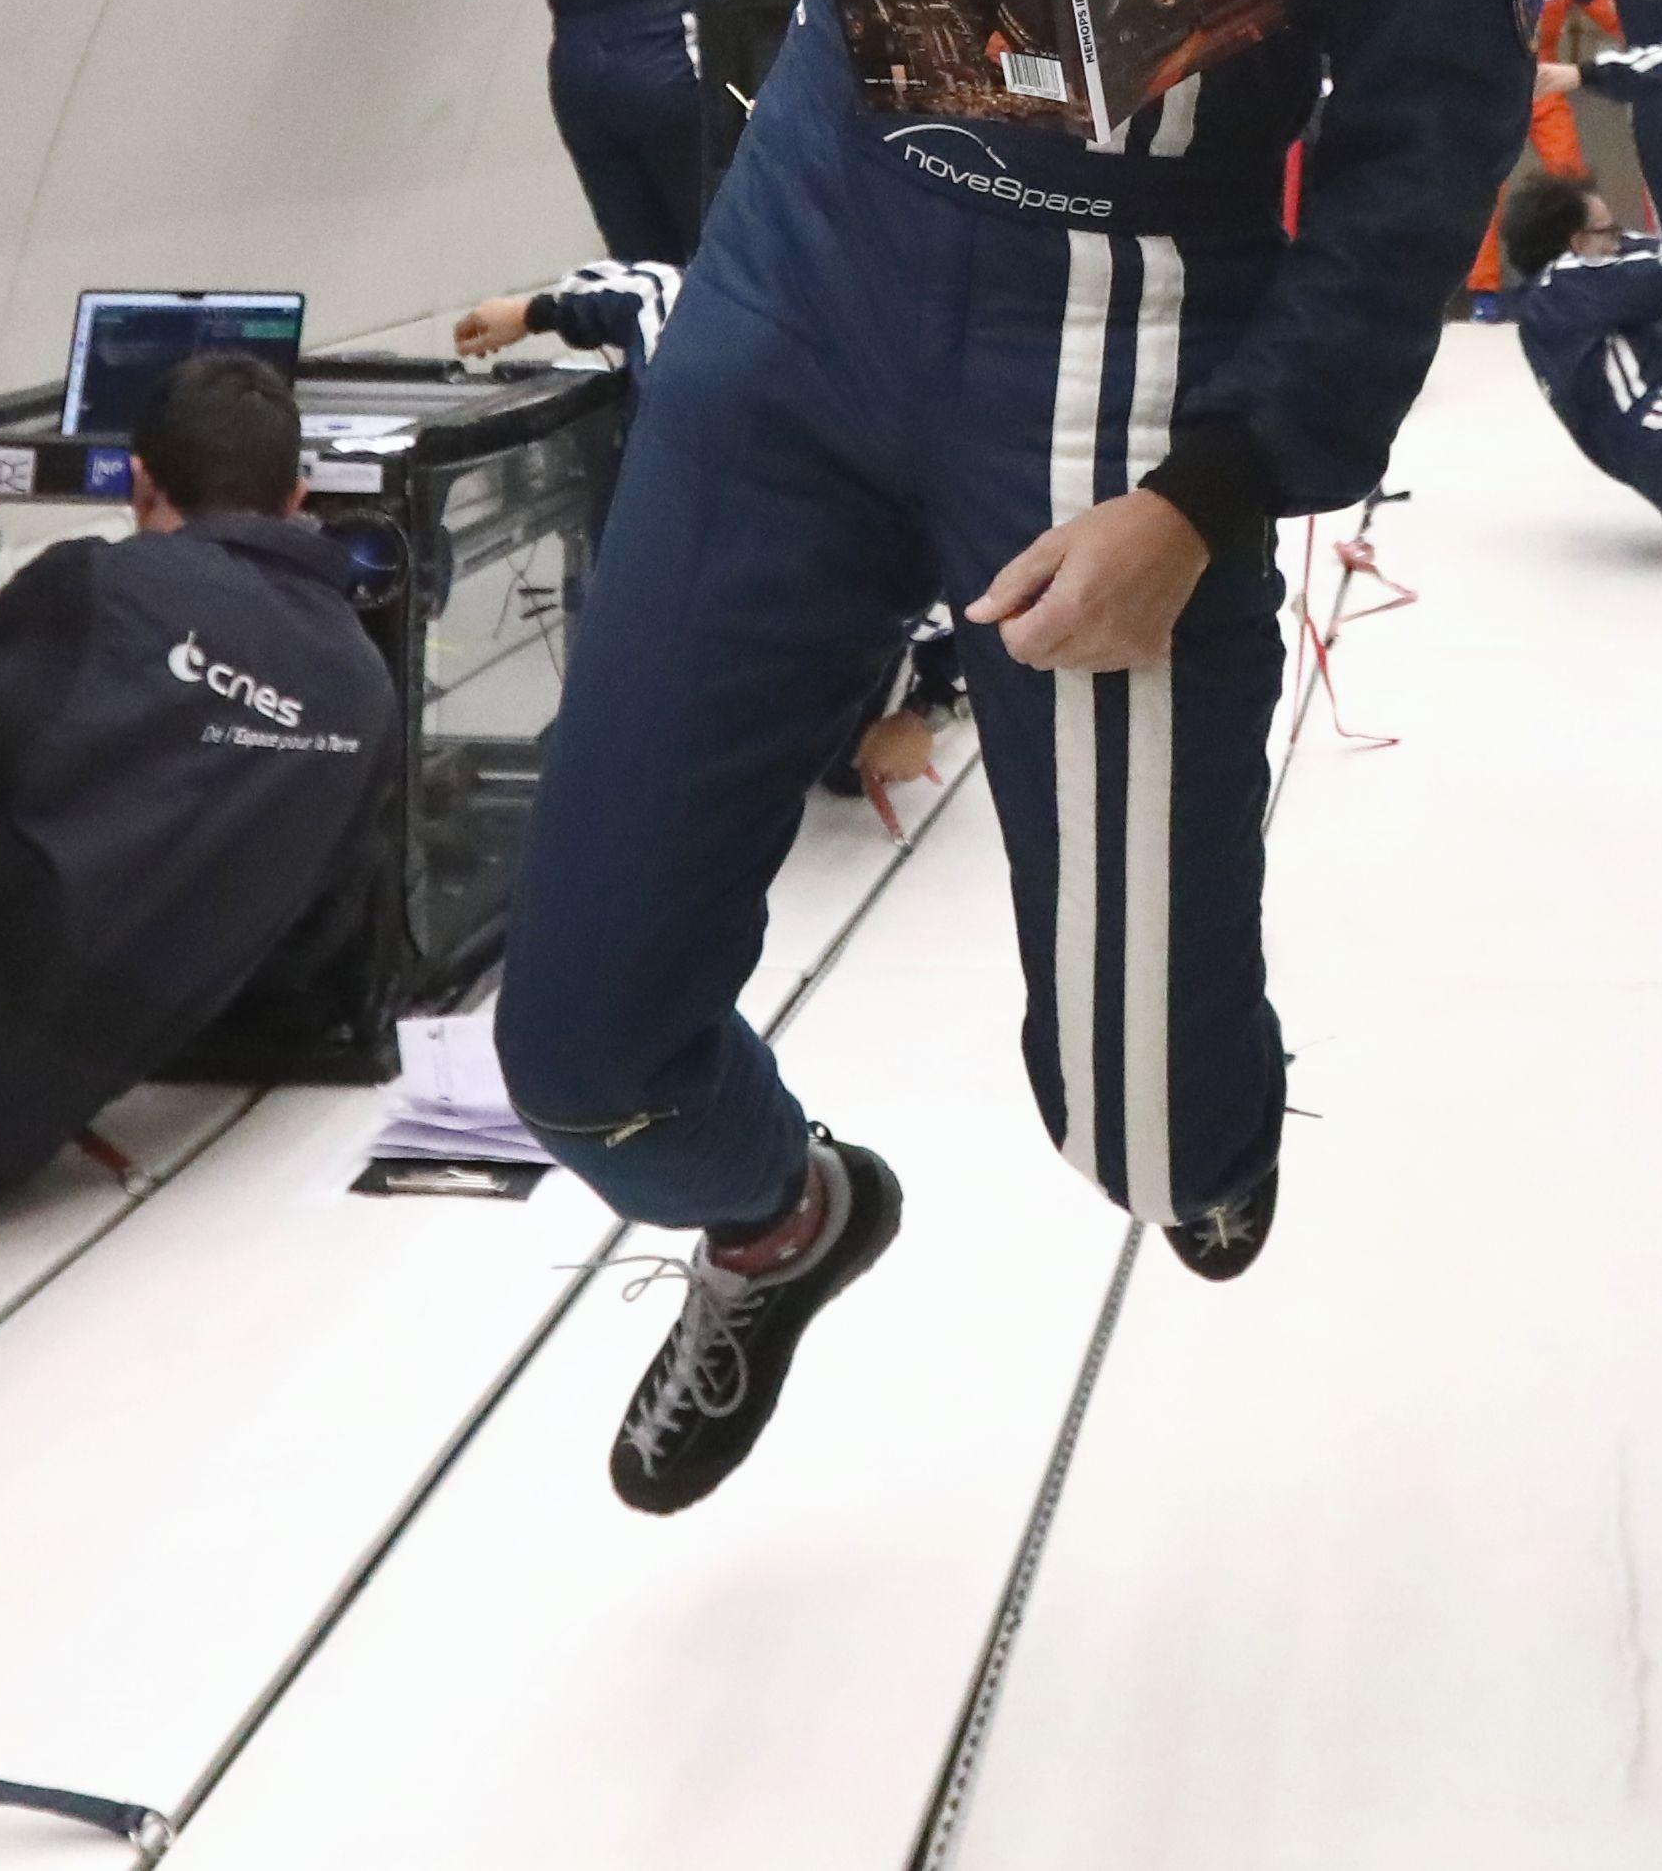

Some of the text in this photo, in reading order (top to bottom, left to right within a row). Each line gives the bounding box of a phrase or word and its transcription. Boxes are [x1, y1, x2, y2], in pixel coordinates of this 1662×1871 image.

[1077, 10, 1096, 64] MEMOPS
[904, 143, 1113, 218] noveSpace
[206, 662, 304, 728] cnes
